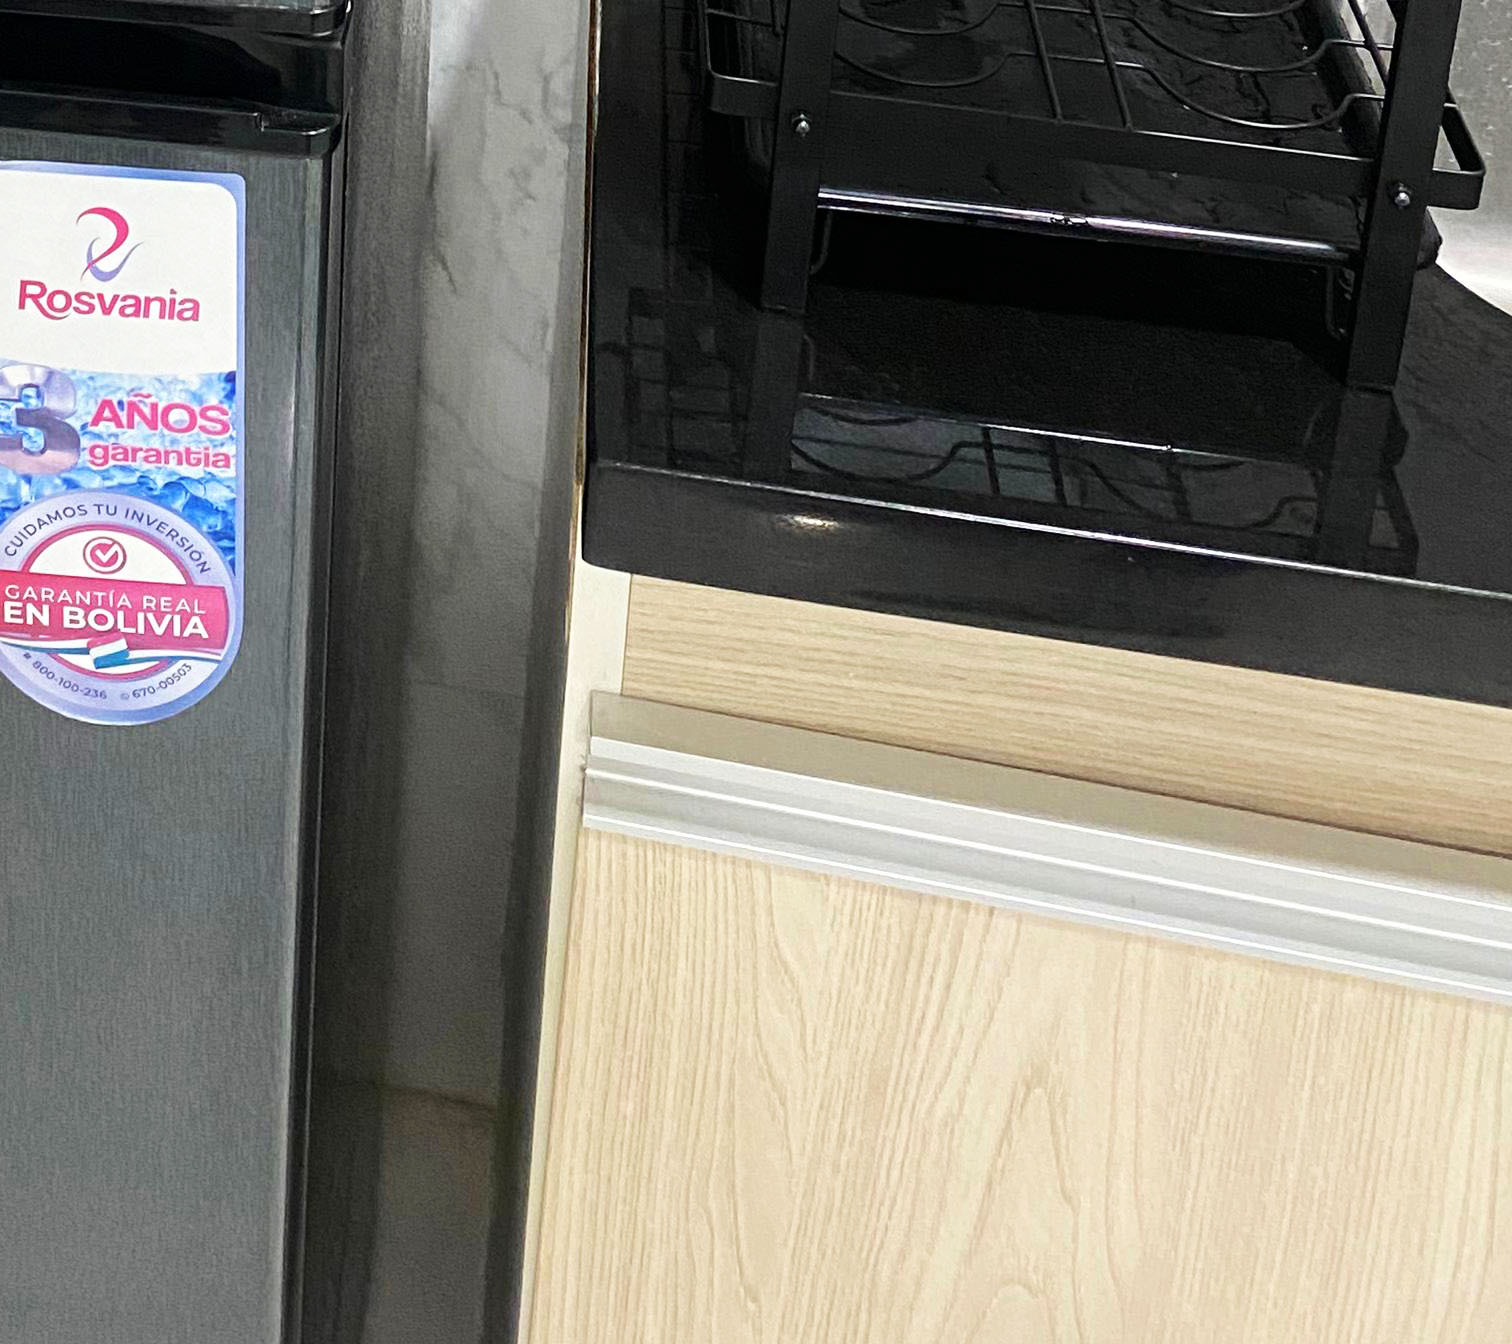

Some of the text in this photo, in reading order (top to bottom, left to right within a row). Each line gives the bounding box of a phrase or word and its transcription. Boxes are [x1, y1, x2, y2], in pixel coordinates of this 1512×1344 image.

[18, 279, 200, 322] Rosvania
[89, 392, 231, 436] AÑOS
[88, 443, 231, 469] garantia
[4, 503, 211, 574] CUIDAMOS TU INVERSIÓN
[5, 585, 206, 614] GARANTÍA REAL
[4, 601, 209, 639] EN BOLIVIA
